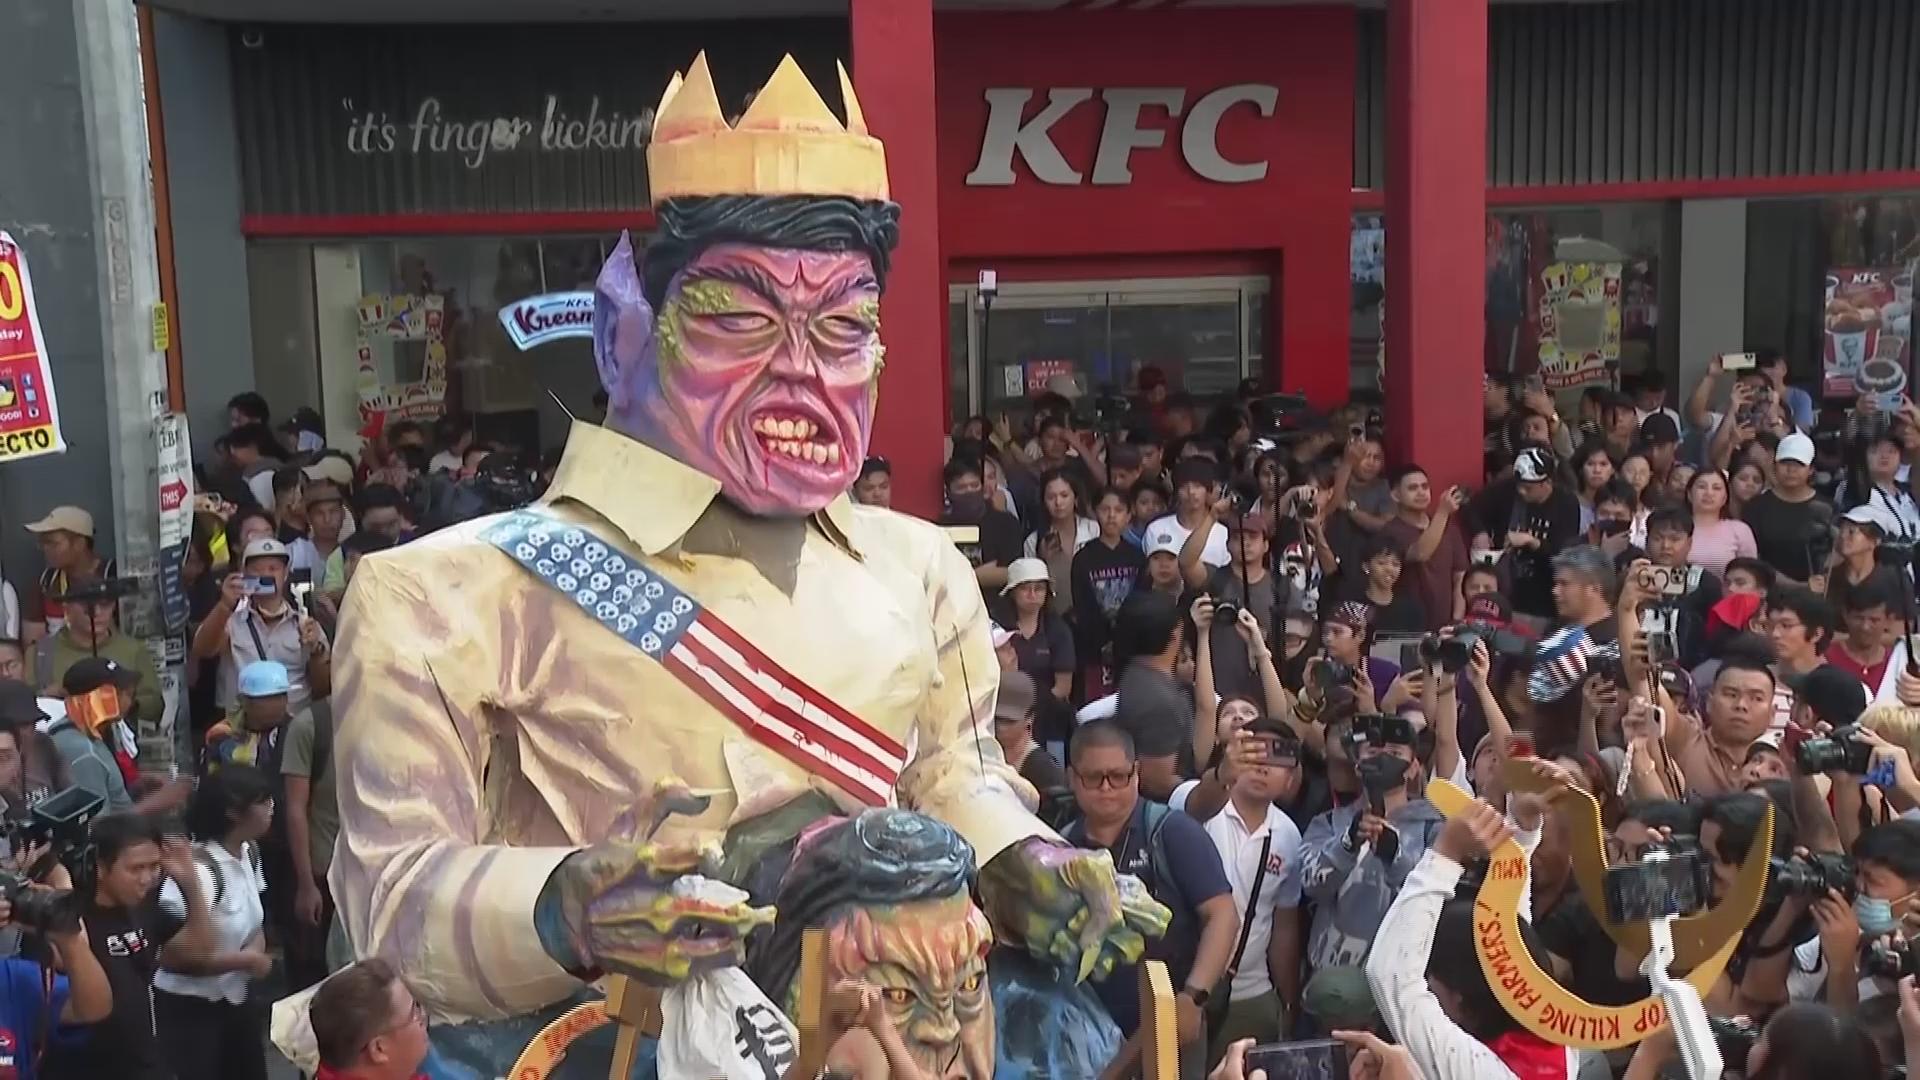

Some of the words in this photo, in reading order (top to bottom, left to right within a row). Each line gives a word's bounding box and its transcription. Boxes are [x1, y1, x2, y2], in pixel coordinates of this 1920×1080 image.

[965, 84, 1279, 185] KFC
[1852, 272, 1880, 284] KFC
[162, 489, 180, 506] THIS
[1492, 857, 1524, 881] KMU
[1537, 1003, 1621, 1041] KILLING
[1634, 1003, 1662, 1028] OP
